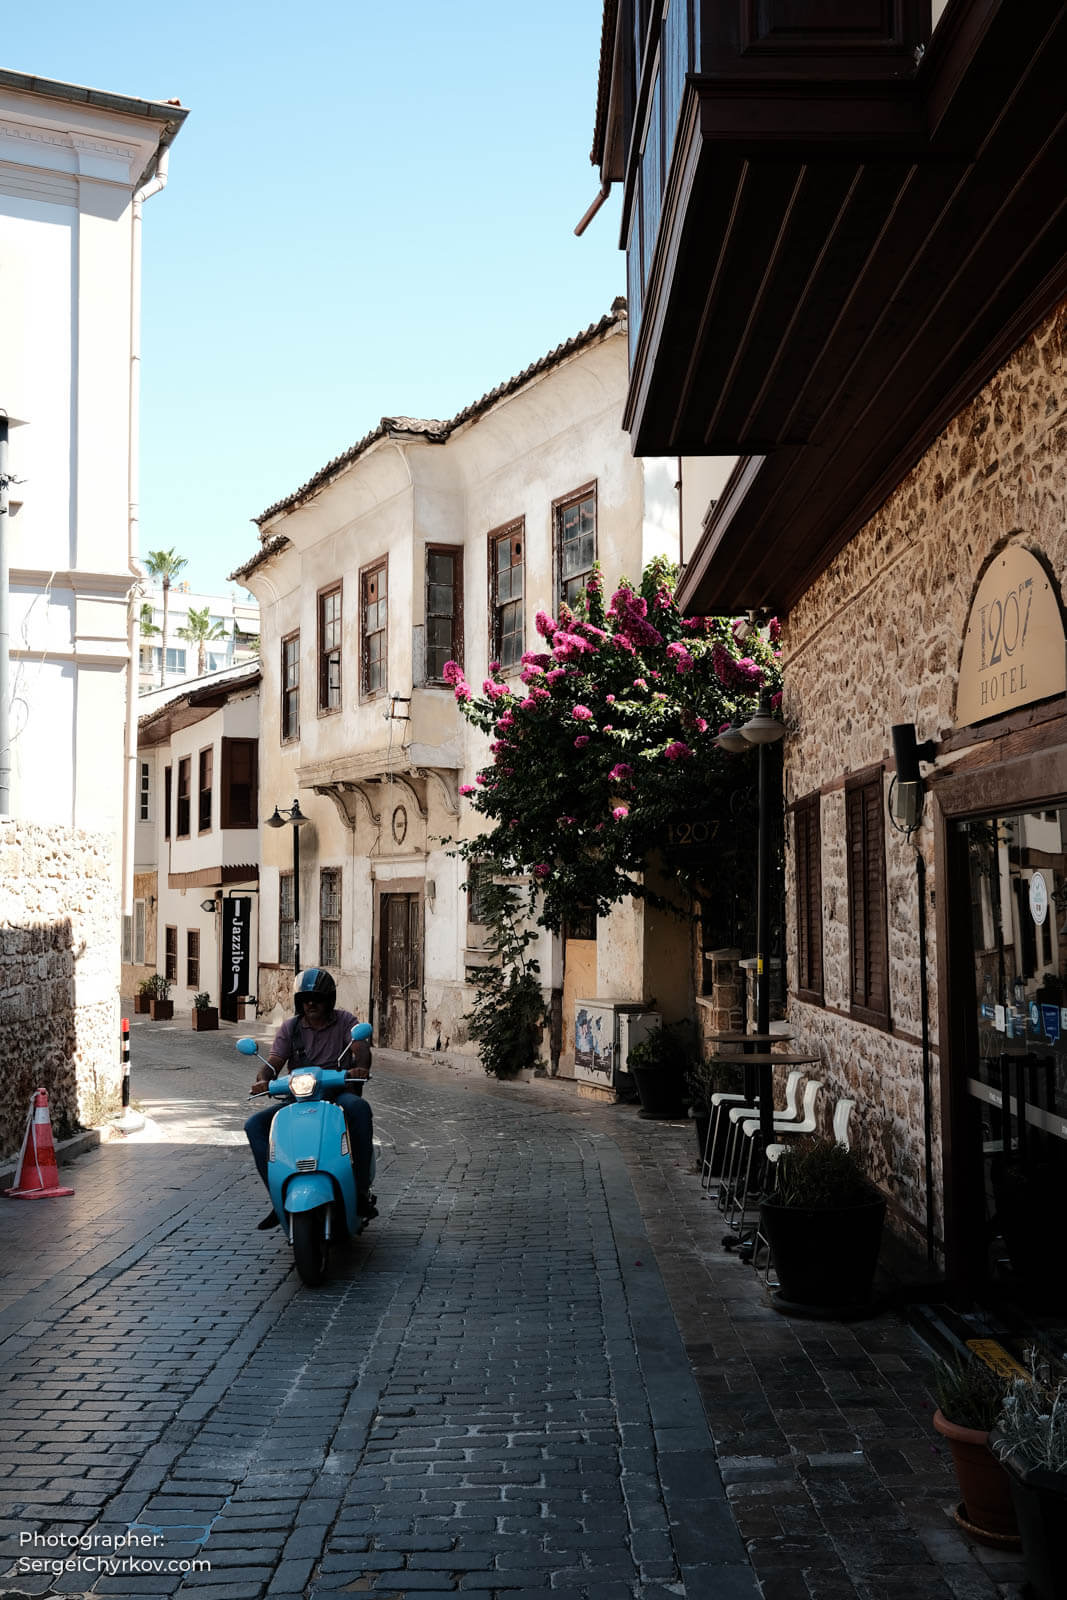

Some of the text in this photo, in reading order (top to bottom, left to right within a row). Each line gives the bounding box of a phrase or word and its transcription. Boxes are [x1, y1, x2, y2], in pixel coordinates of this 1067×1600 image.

[978, 578, 1032, 672] 1207
[980, 664, 1027, 705] HOTEL
[665, 820, 720, 845] 1207
[232, 918, 244, 972] Jazzibe
